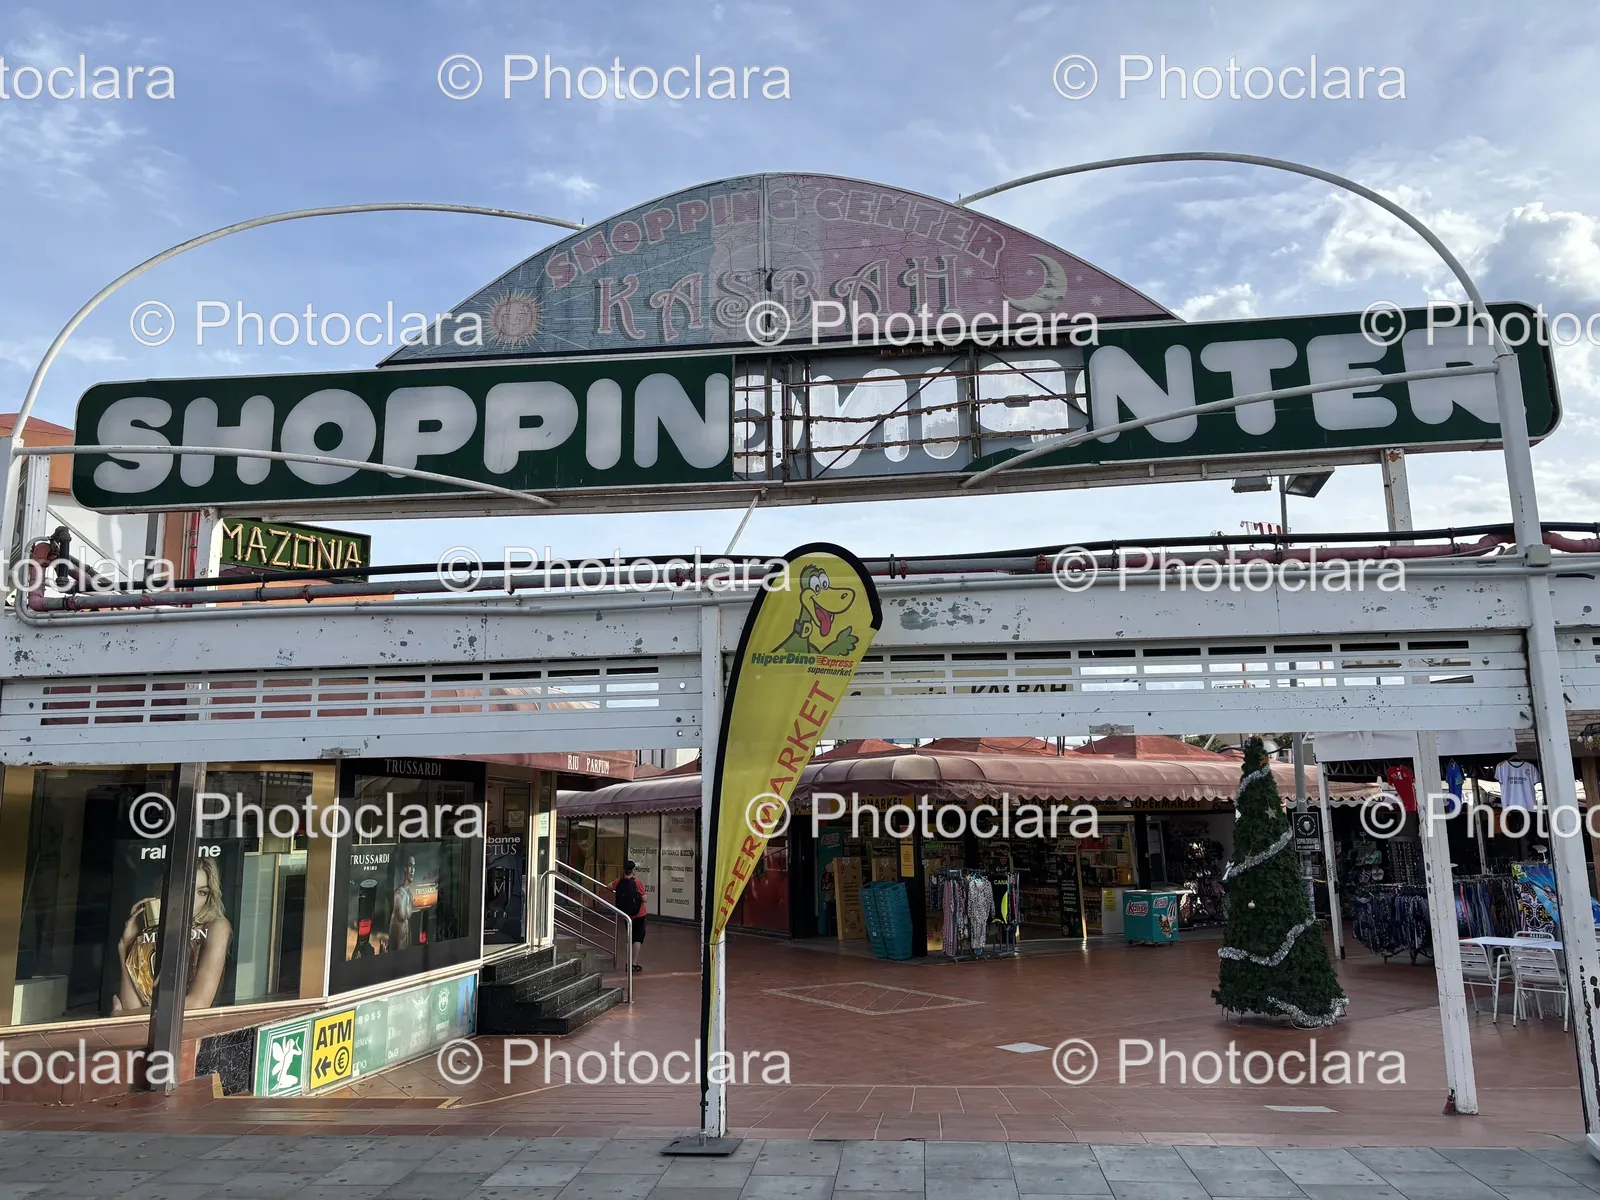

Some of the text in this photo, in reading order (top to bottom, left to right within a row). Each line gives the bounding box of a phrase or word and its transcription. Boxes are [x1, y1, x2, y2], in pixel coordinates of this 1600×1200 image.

[545, 188, 1006, 289] SHOPPING CENTER
[596, 254, 962, 341] KASBAH
[751, 653, 854, 668] HiperDino Express
[807, 666, 853, 677] supermarket
[385, 759, 442, 776] TRUSSARDI
[567, 755, 580, 770] RIU
[316, 1018, 352, 1051] ATM
